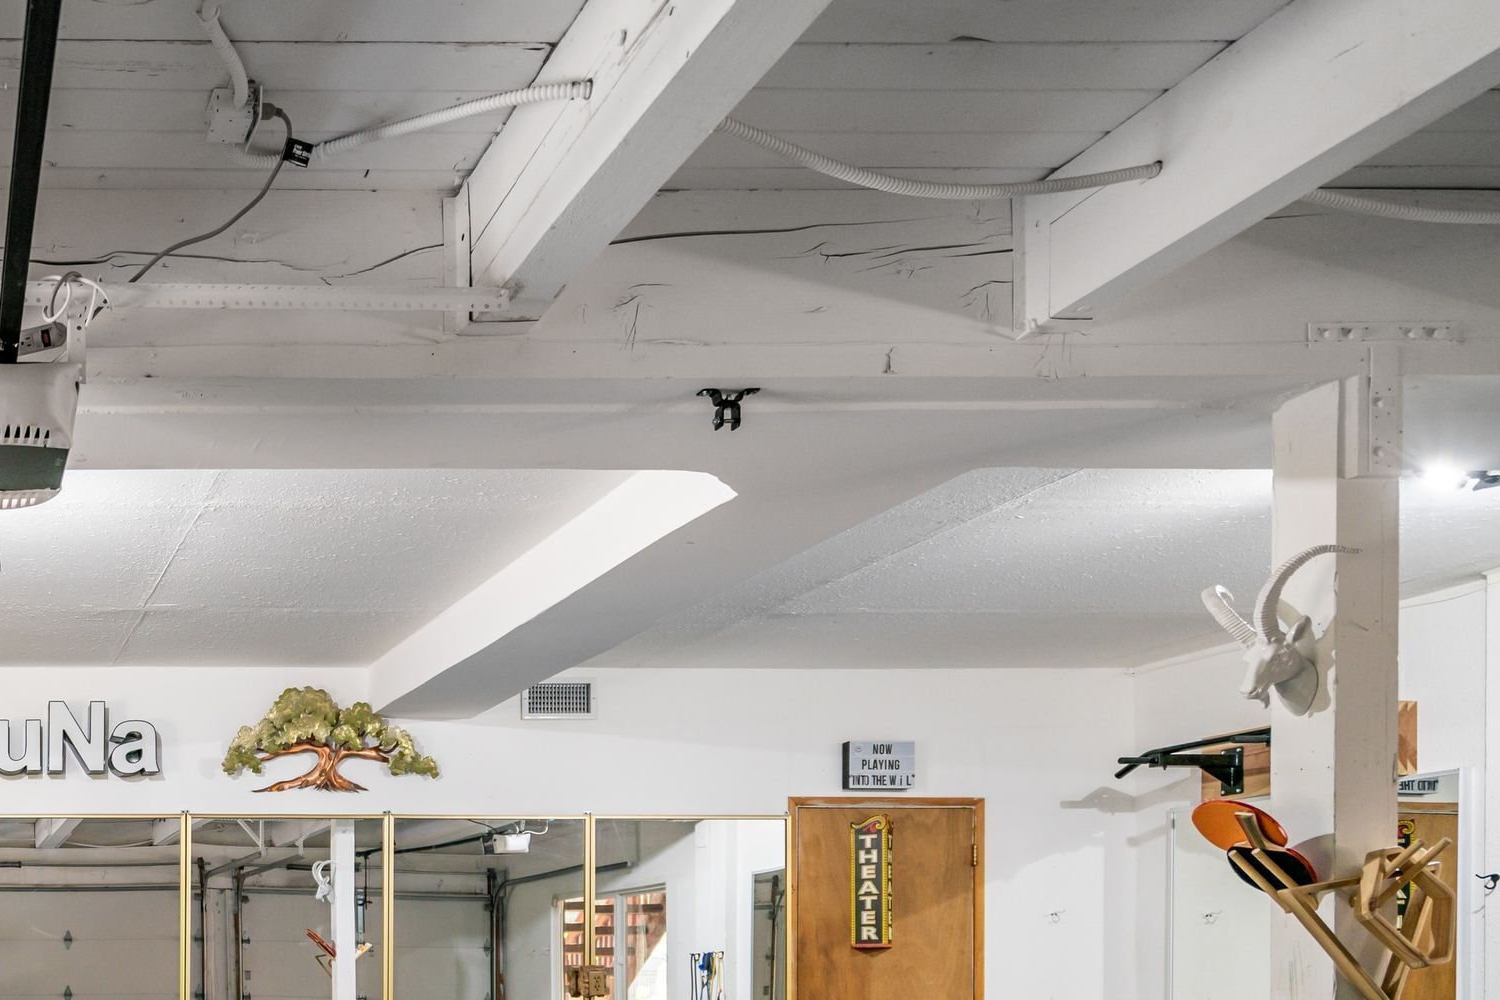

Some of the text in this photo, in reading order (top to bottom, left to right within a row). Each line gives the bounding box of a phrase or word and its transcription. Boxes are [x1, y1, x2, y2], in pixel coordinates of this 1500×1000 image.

[872, 743, 893, 755] NOW
[861, 759, 900, 770] PLAYING
[871, 774, 887, 786] THE
[857, 833, 880, 941] THEATER
